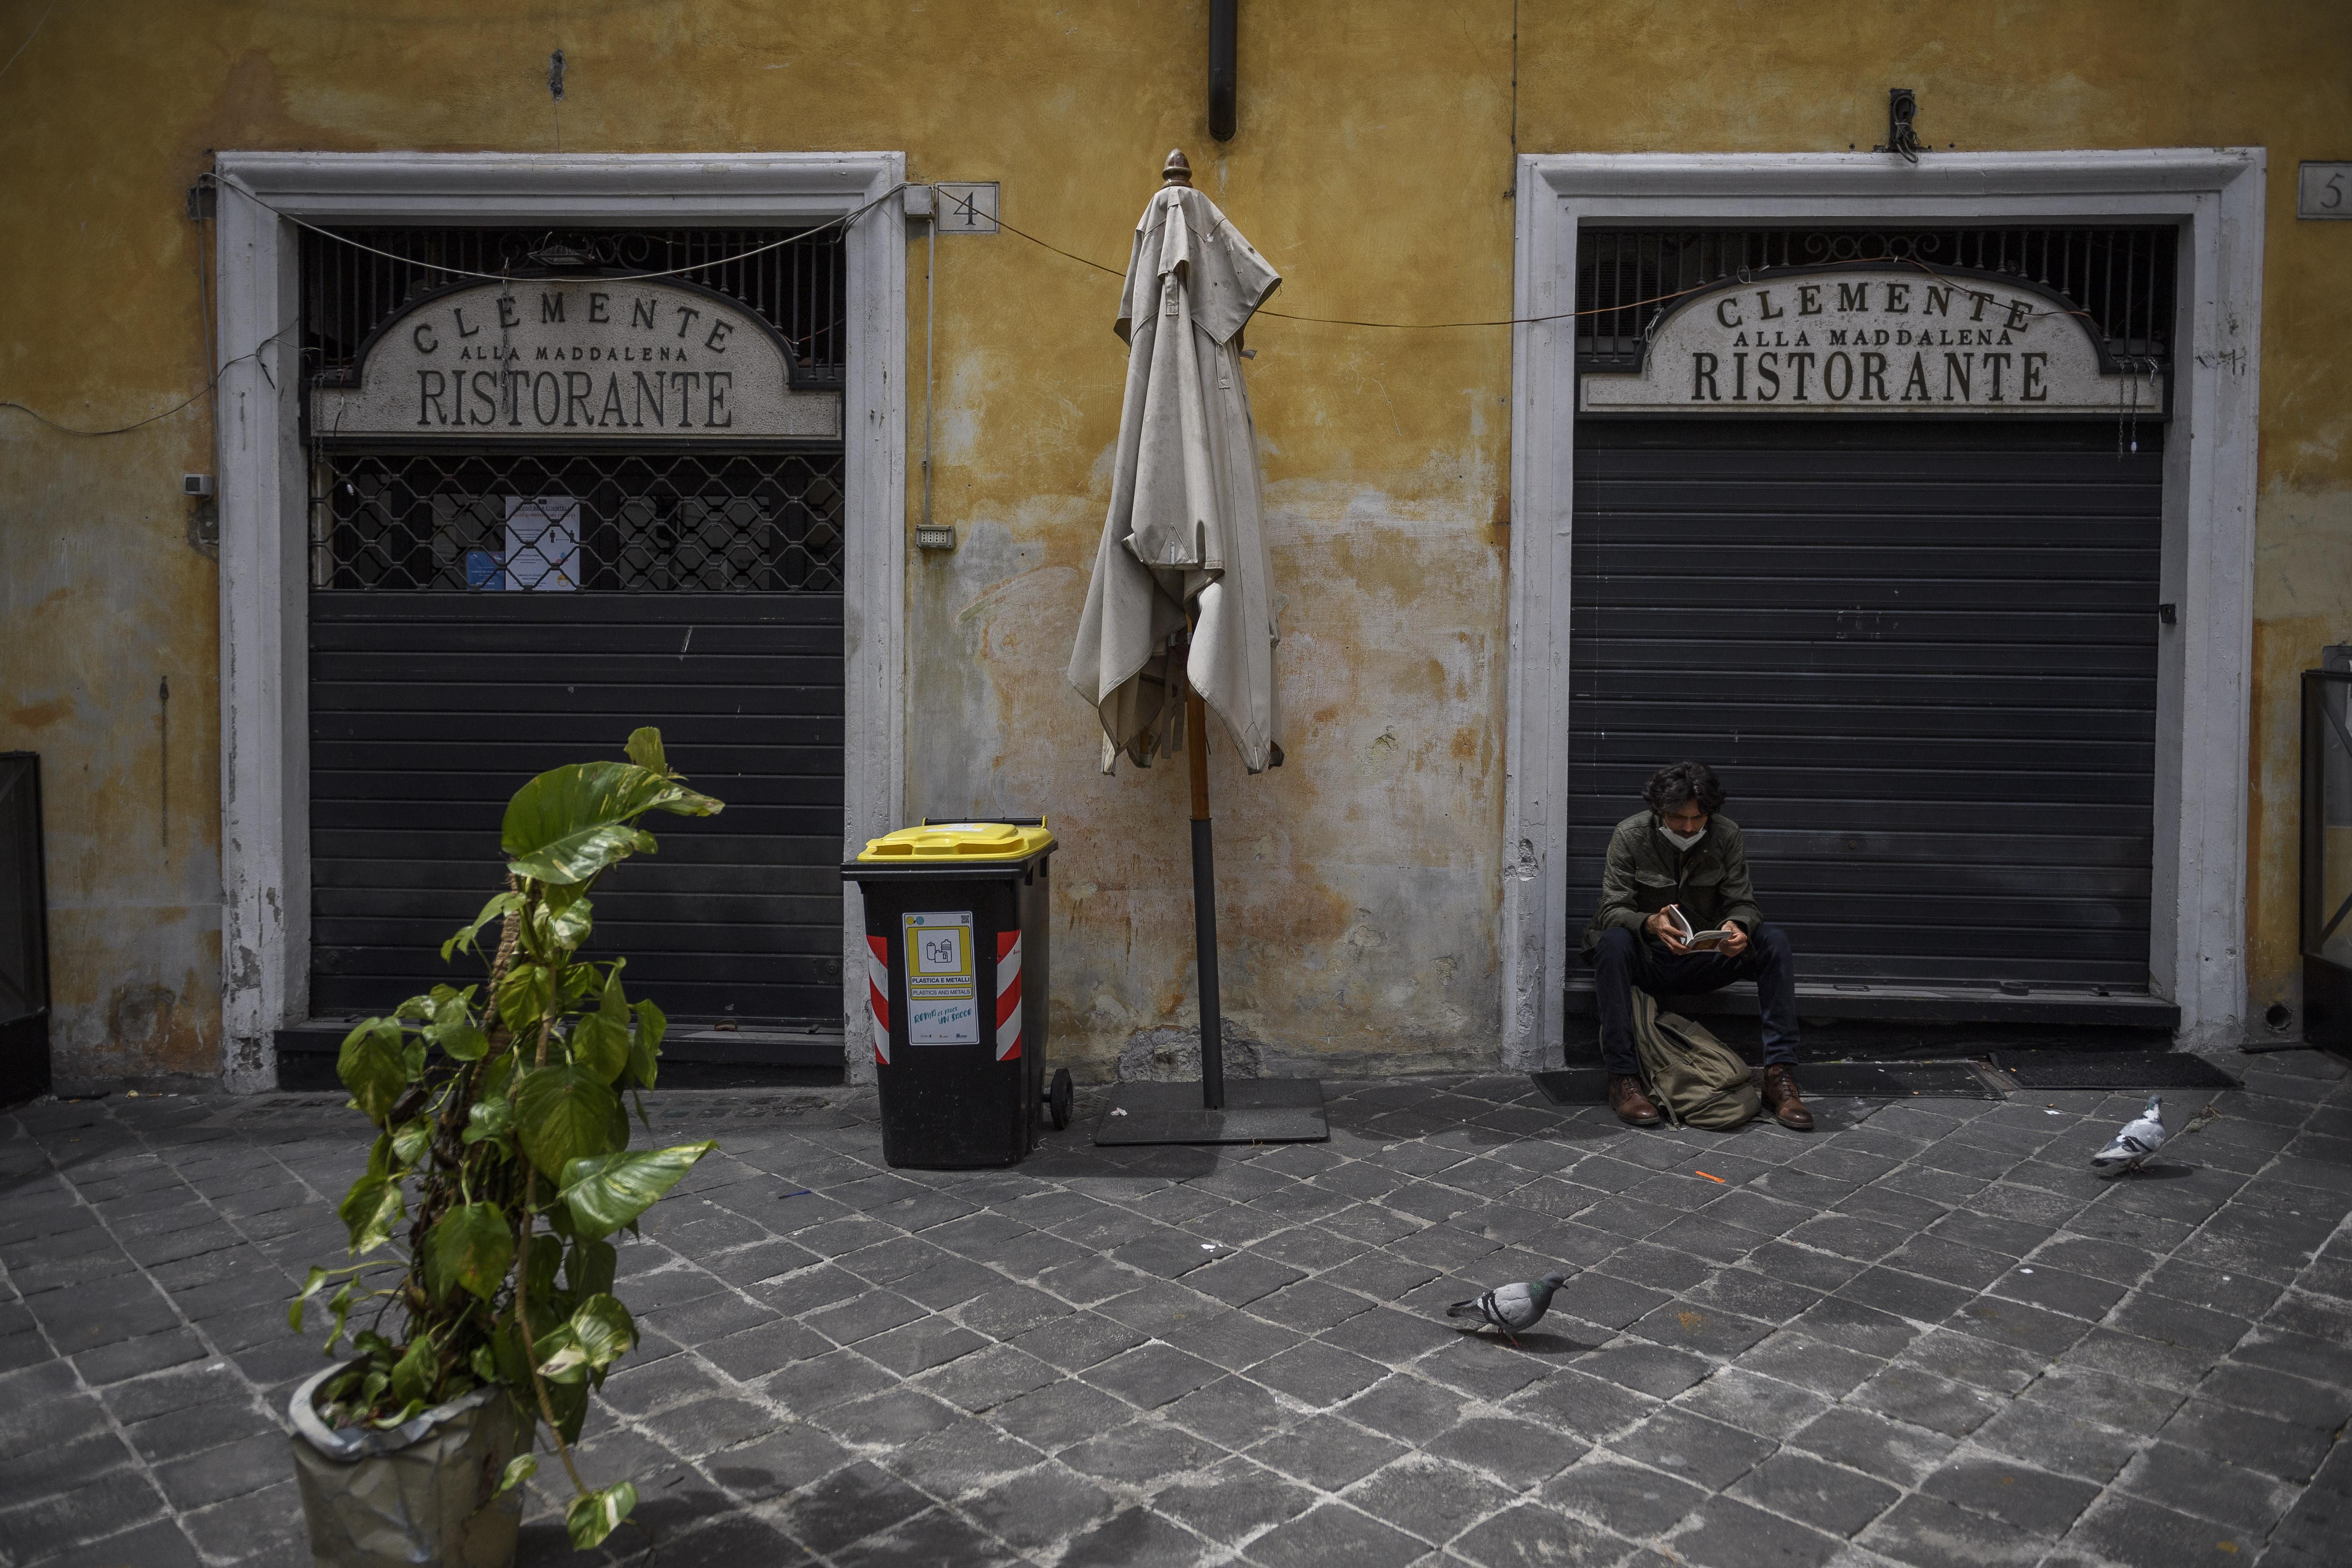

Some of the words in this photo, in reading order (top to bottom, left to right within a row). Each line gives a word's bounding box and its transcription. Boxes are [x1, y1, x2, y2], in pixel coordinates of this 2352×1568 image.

[953, 191, 979, 226] 4
[2320, 172, 2345, 209] 5
[413, 291, 735, 354] CLEMENTE
[1717, 283, 2034, 333] CLEMENTE
[460, 346, 520, 359] ALLA
[535, 346, 688, 361] MADDALENA
[1733, 331, 1810, 347] ALLA
[1829, 329, 2014, 346] MADDALENA
[1691, 351, 2047, 401] RISTORANTE
[416, 370, 732, 427] RISTORANTE
[914, 1009, 936, 1024] ROMA
[938, 1015, 949, 1024] UN
[951, 1008, 972, 1021] SACCO
